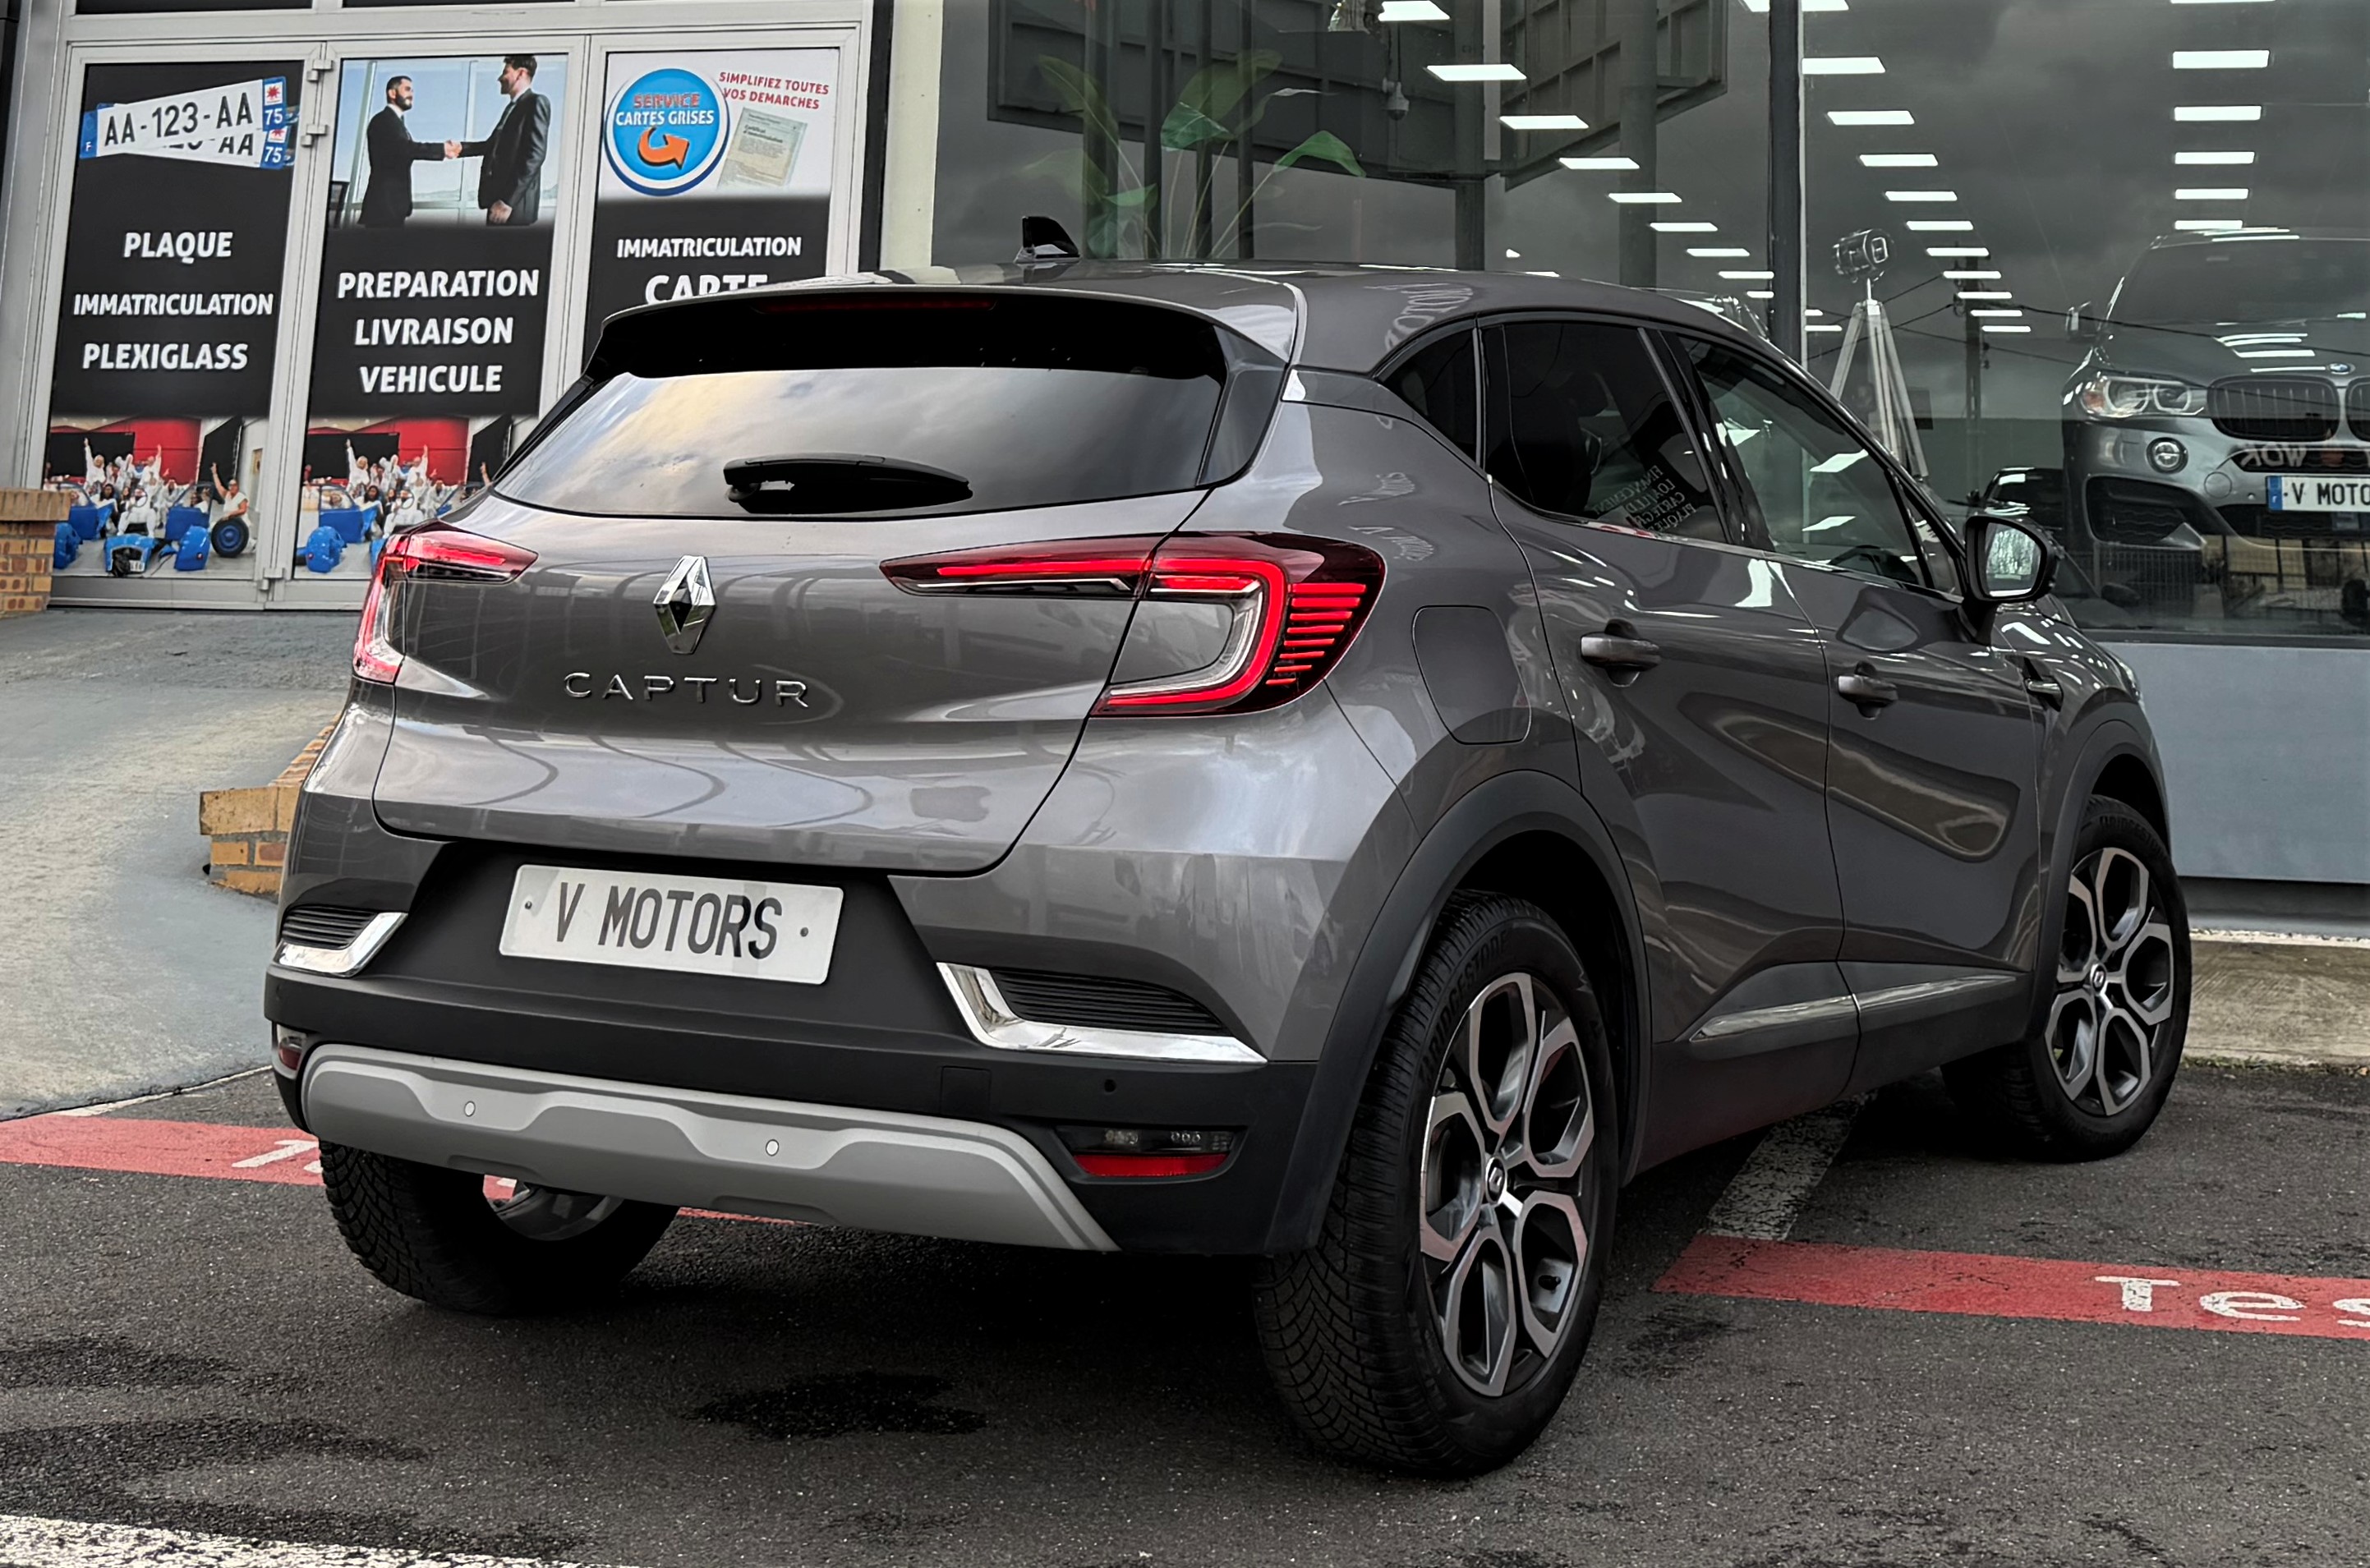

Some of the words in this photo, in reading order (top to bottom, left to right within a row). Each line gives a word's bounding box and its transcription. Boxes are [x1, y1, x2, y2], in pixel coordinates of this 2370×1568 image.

[719, 71, 782, 89] SIMPLIFIEZ
[785, 80, 829, 94] TOUTES
[633, 93, 700, 108] SERVICE
[723, 88, 746, 100] VOS
[748, 91, 820, 109] DEMARCHES
[265, 108, 283, 126] 75
[615, 111, 665, 126] CARTES
[668, 110, 714, 125] GRISES
[265, 146, 283, 163] 75
[124, 232, 233, 264] PLAQUE
[617, 237, 802, 258] IMMATRICULATION
[338, 269, 539, 298] PREPARATION
[73, 293, 274, 315] IMMATRICULATION
[354, 317, 513, 345] LIVRAISON
[82, 343, 248, 369] PLEXIGLASS
[359, 365, 503, 393] VEHICULE
[2292, 482, 2305, 504] V
[564, 671, 810, 709] CAPTUR
[556, 881, 586, 943] V
[597, 885, 784, 959] MOTORS
